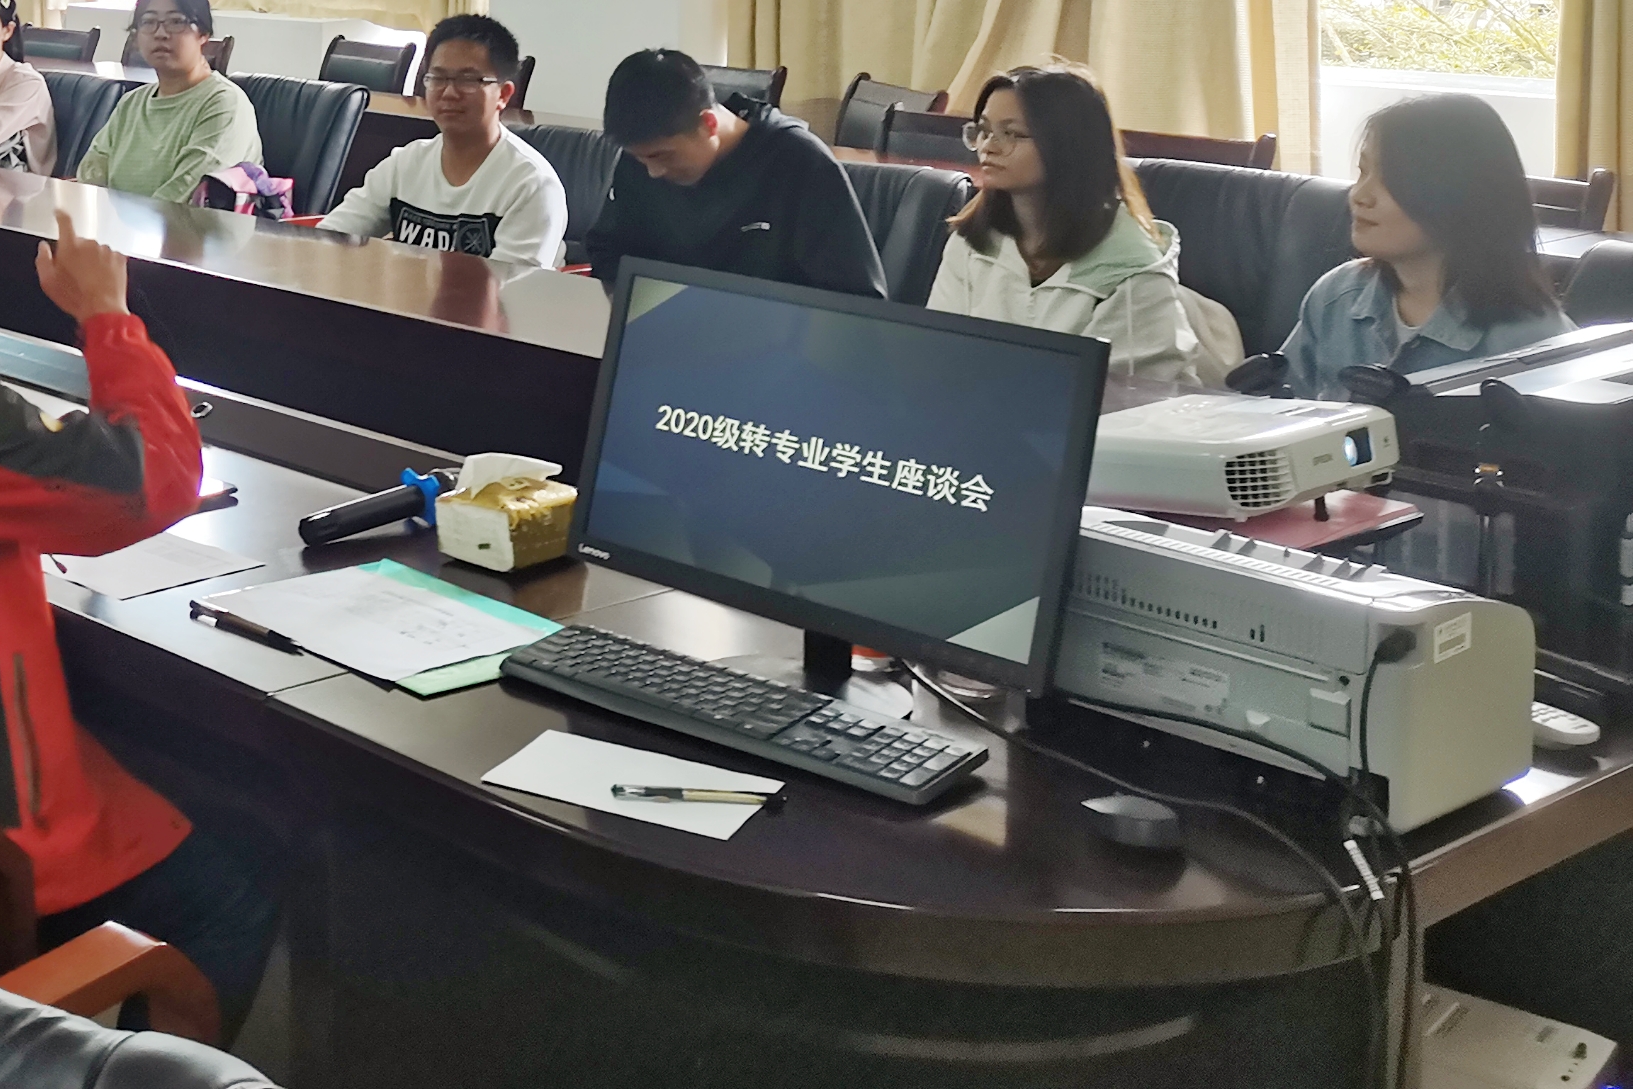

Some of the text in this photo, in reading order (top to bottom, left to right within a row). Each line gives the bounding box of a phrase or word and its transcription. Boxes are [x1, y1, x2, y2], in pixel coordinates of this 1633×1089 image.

[399, 219, 456, 253] WAD
[655, 404, 995, 513] 2020级转专业学生座谈会
[578, 542, 611, 560] Lenovo
